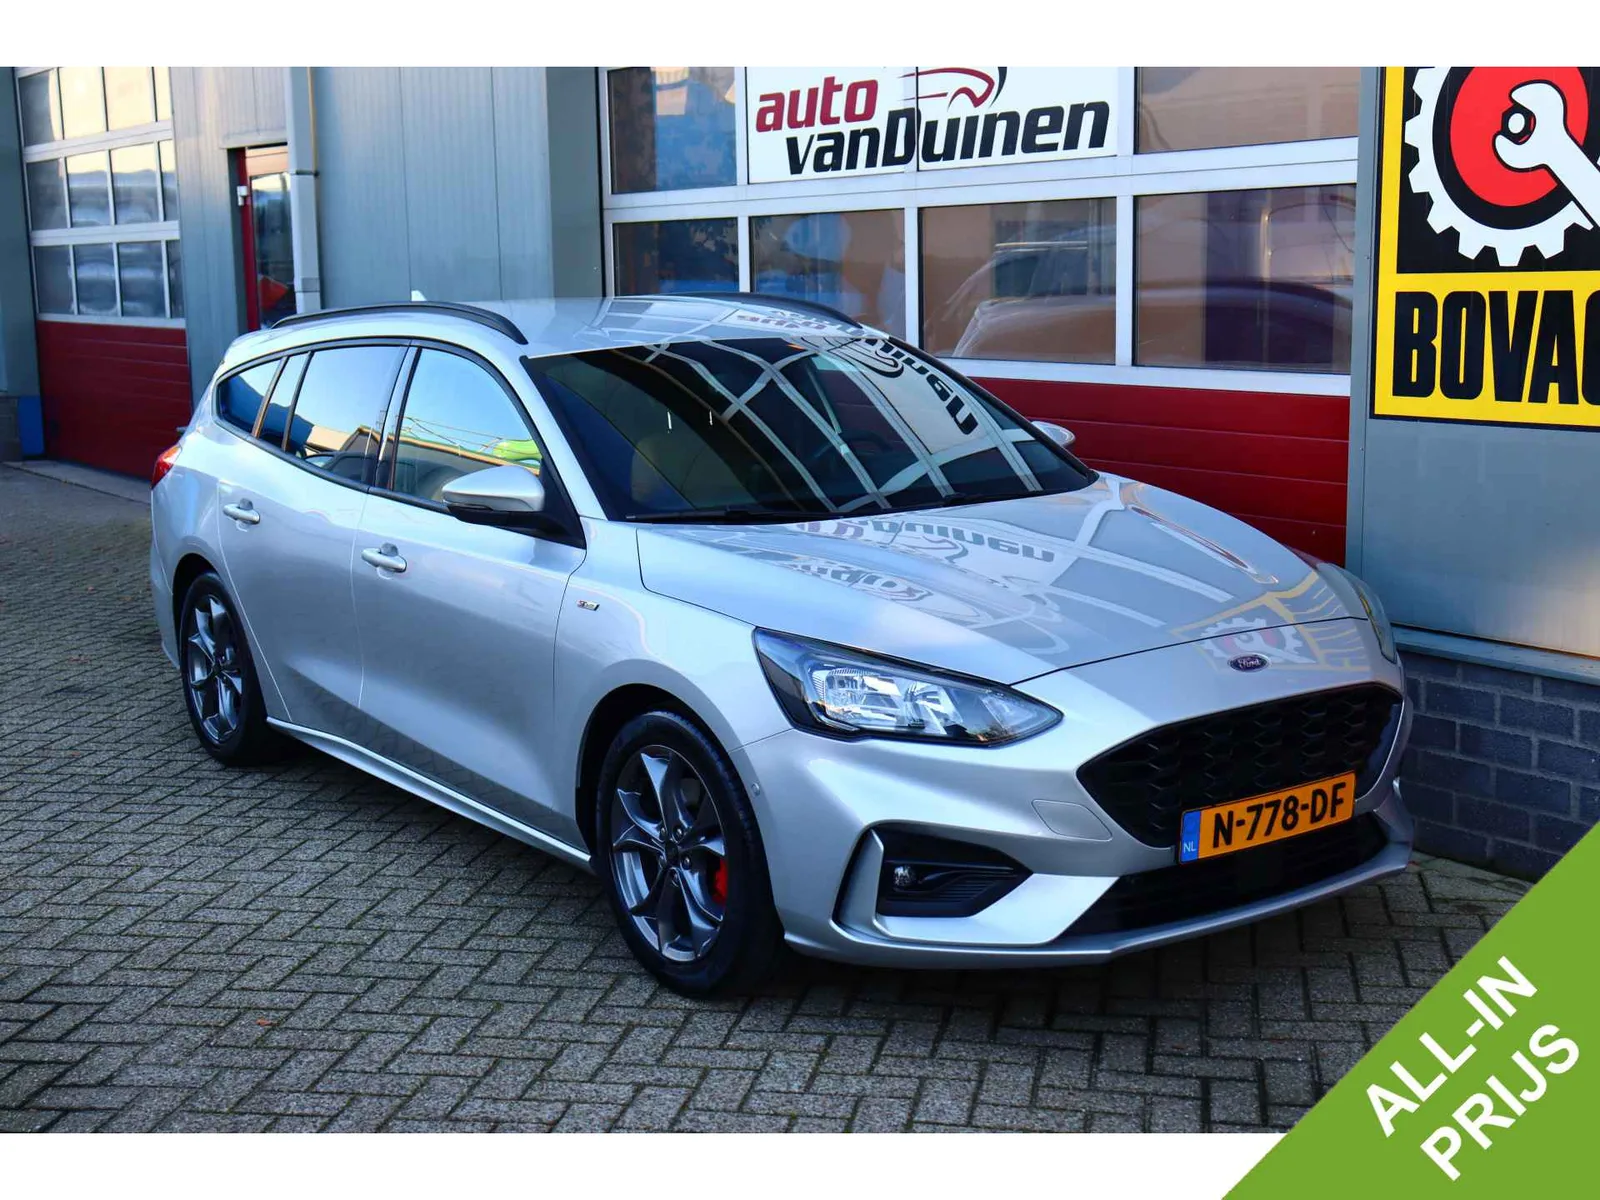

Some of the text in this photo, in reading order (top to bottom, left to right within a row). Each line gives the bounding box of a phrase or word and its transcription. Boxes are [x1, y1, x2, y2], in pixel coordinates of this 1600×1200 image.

[756, 76, 878, 133] auto
[785, 100, 1110, 175] vanDuinen
[1212, 782, 1346, 848] N-778-DF
[1183, 841, 1197, 852] NL
